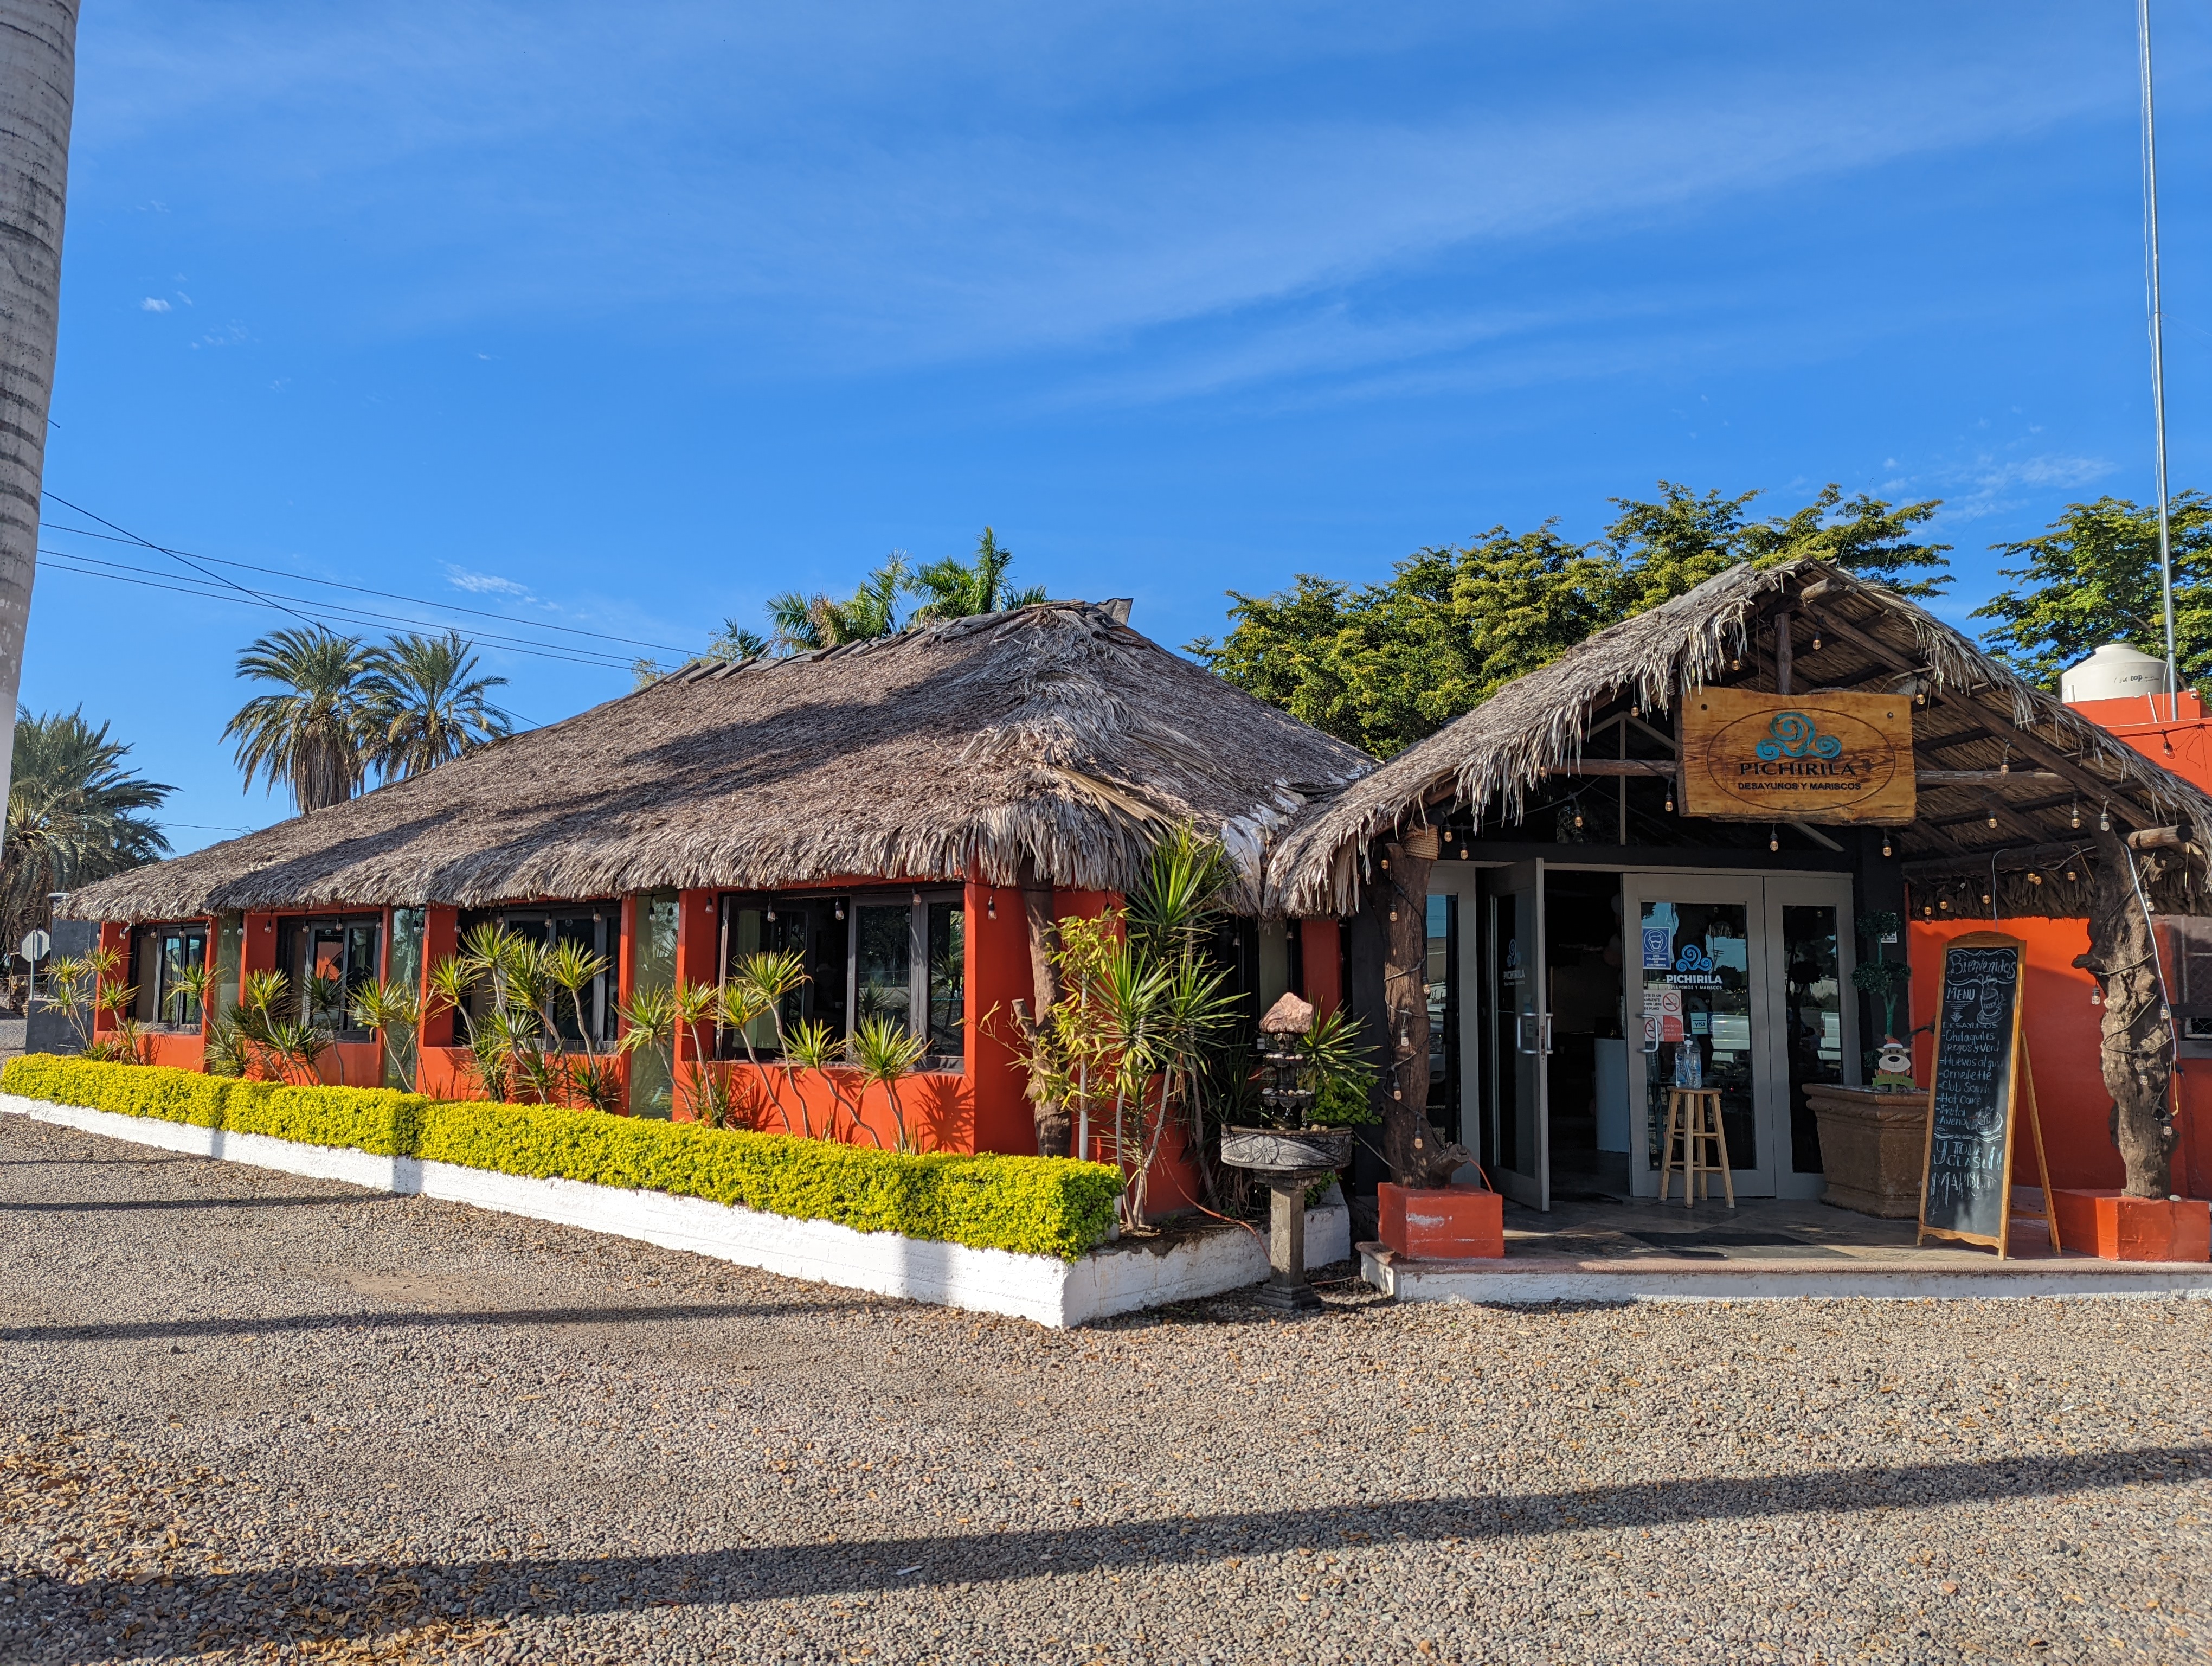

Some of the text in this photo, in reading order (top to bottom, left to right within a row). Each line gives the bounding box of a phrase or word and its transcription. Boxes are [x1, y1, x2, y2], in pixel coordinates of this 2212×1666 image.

[1740, 762, 1856, 776] PICHIRILA
[1738, 782, 1798, 790] DESAYUNOS
[1809, 782, 1862, 790] MARISCOS
[1947, 954, 2017, 979] Bienvenidos
[1666, 975, 1723, 984] PICHIRILA
[1947, 987, 1976, 1001] MENU
